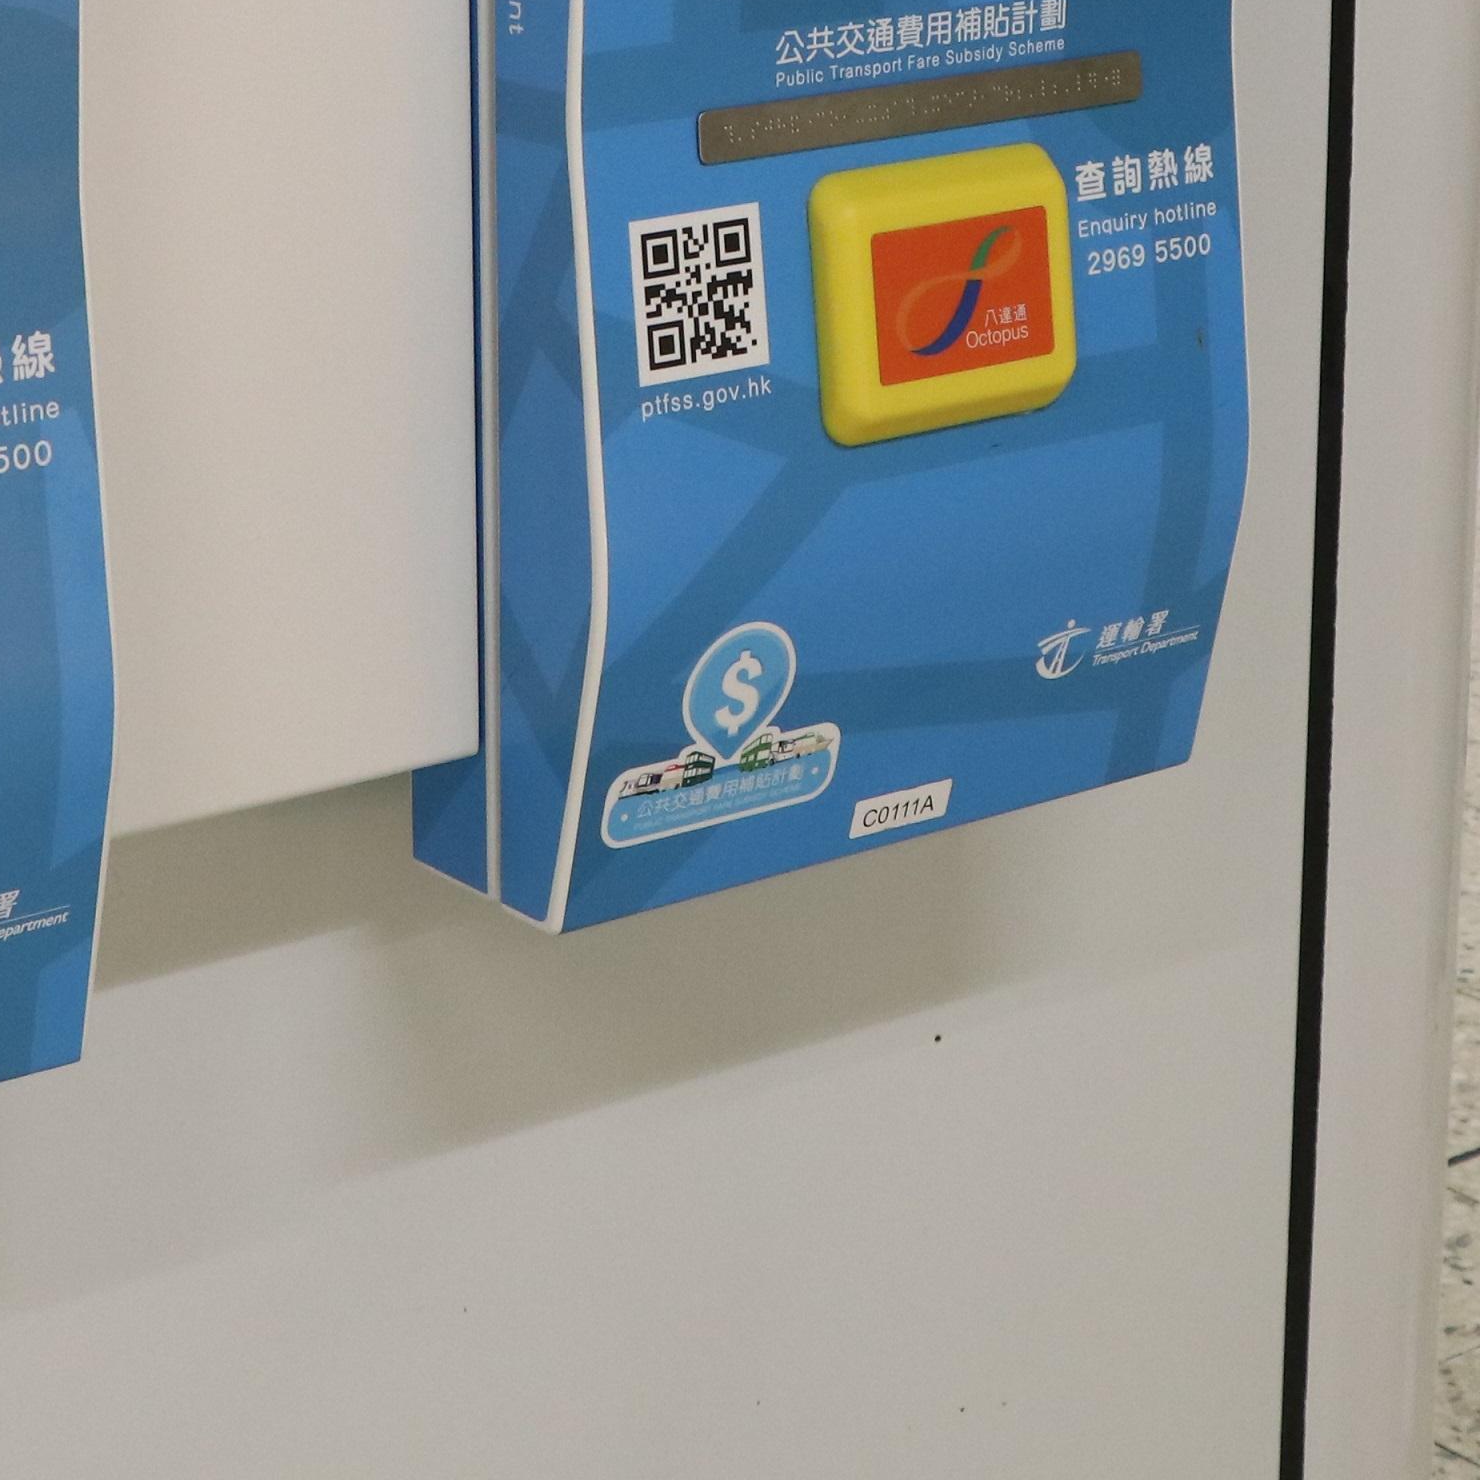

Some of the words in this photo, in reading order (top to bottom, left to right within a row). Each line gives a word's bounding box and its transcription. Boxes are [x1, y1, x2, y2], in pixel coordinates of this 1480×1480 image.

[775, 69, 823, 88] Public
[830, 58, 902, 81] Transport
[908, 54, 939, 70] Fare
[946, 43, 1003, 66] Subsidy
[1009, 38, 1064, 57] Scheme
[1075, 142, 1215, 204] 查詢熱線
[1079, 212, 1147, 238] Enquiry
[1155, 201, 1216, 223] hotline
[1088, 243, 1144, 276] 2969
[1156, 233, 1210, 263] 5500
[983, 302, 1028, 328] 八達通
[965, 323, 1029, 351] Octopus
[640, 376, 772, 421] ptfss.gov.hk
[1091, 643, 1137, 668] Transport
[1140, 629, 1199, 656] Department
[1094, 610, 1170, 651] 運輸署
[861, 794, 935, 829] C0111A
